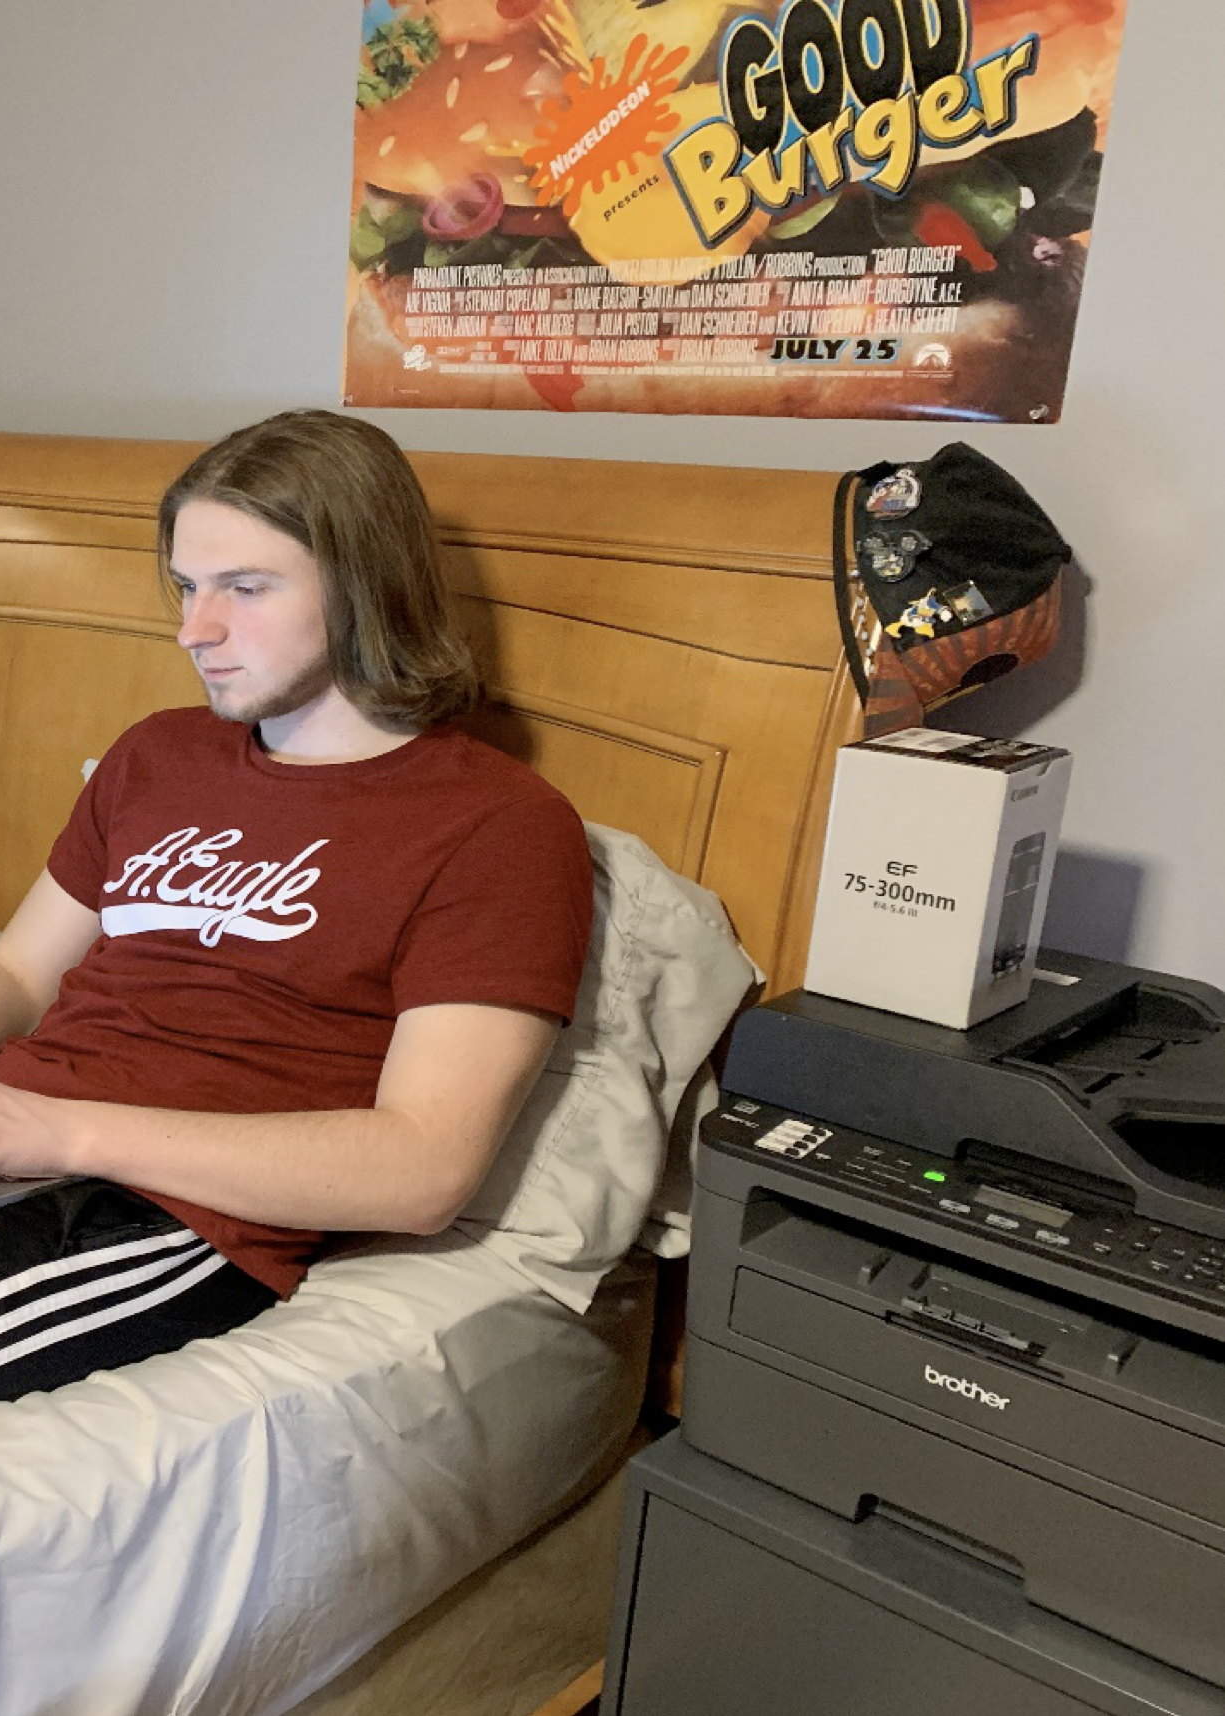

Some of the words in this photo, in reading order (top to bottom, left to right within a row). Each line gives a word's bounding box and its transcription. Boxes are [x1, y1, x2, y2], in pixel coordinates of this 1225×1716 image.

[722, 0, 968, 155] GOOD
[548, 79, 652, 181] NICKELODEON
[668, 35, 1037, 244] Burger
[602, 174, 660, 222] presents
[413, 265, 462, 289] PARAMOUNT
[463, 263, 502, 288] PICTURES
[814, 255, 867, 277] PRODUCTION
[506, 287, 551, 312] COPELAND
[691, 284, 715, 308] DAN
[715, 281, 771, 308] SCHNEIDER
[791, 279, 825, 306] ANITA
[702, 310, 758, 336] SCHNEIDER
[770, 338, 846, 360] JULY
[855, 338, 900, 360] 25
[886, 860, 919, 878] EF
[844, 872, 957, 912] 75-300mm
[924, 1364, 1011, 1411] brother
